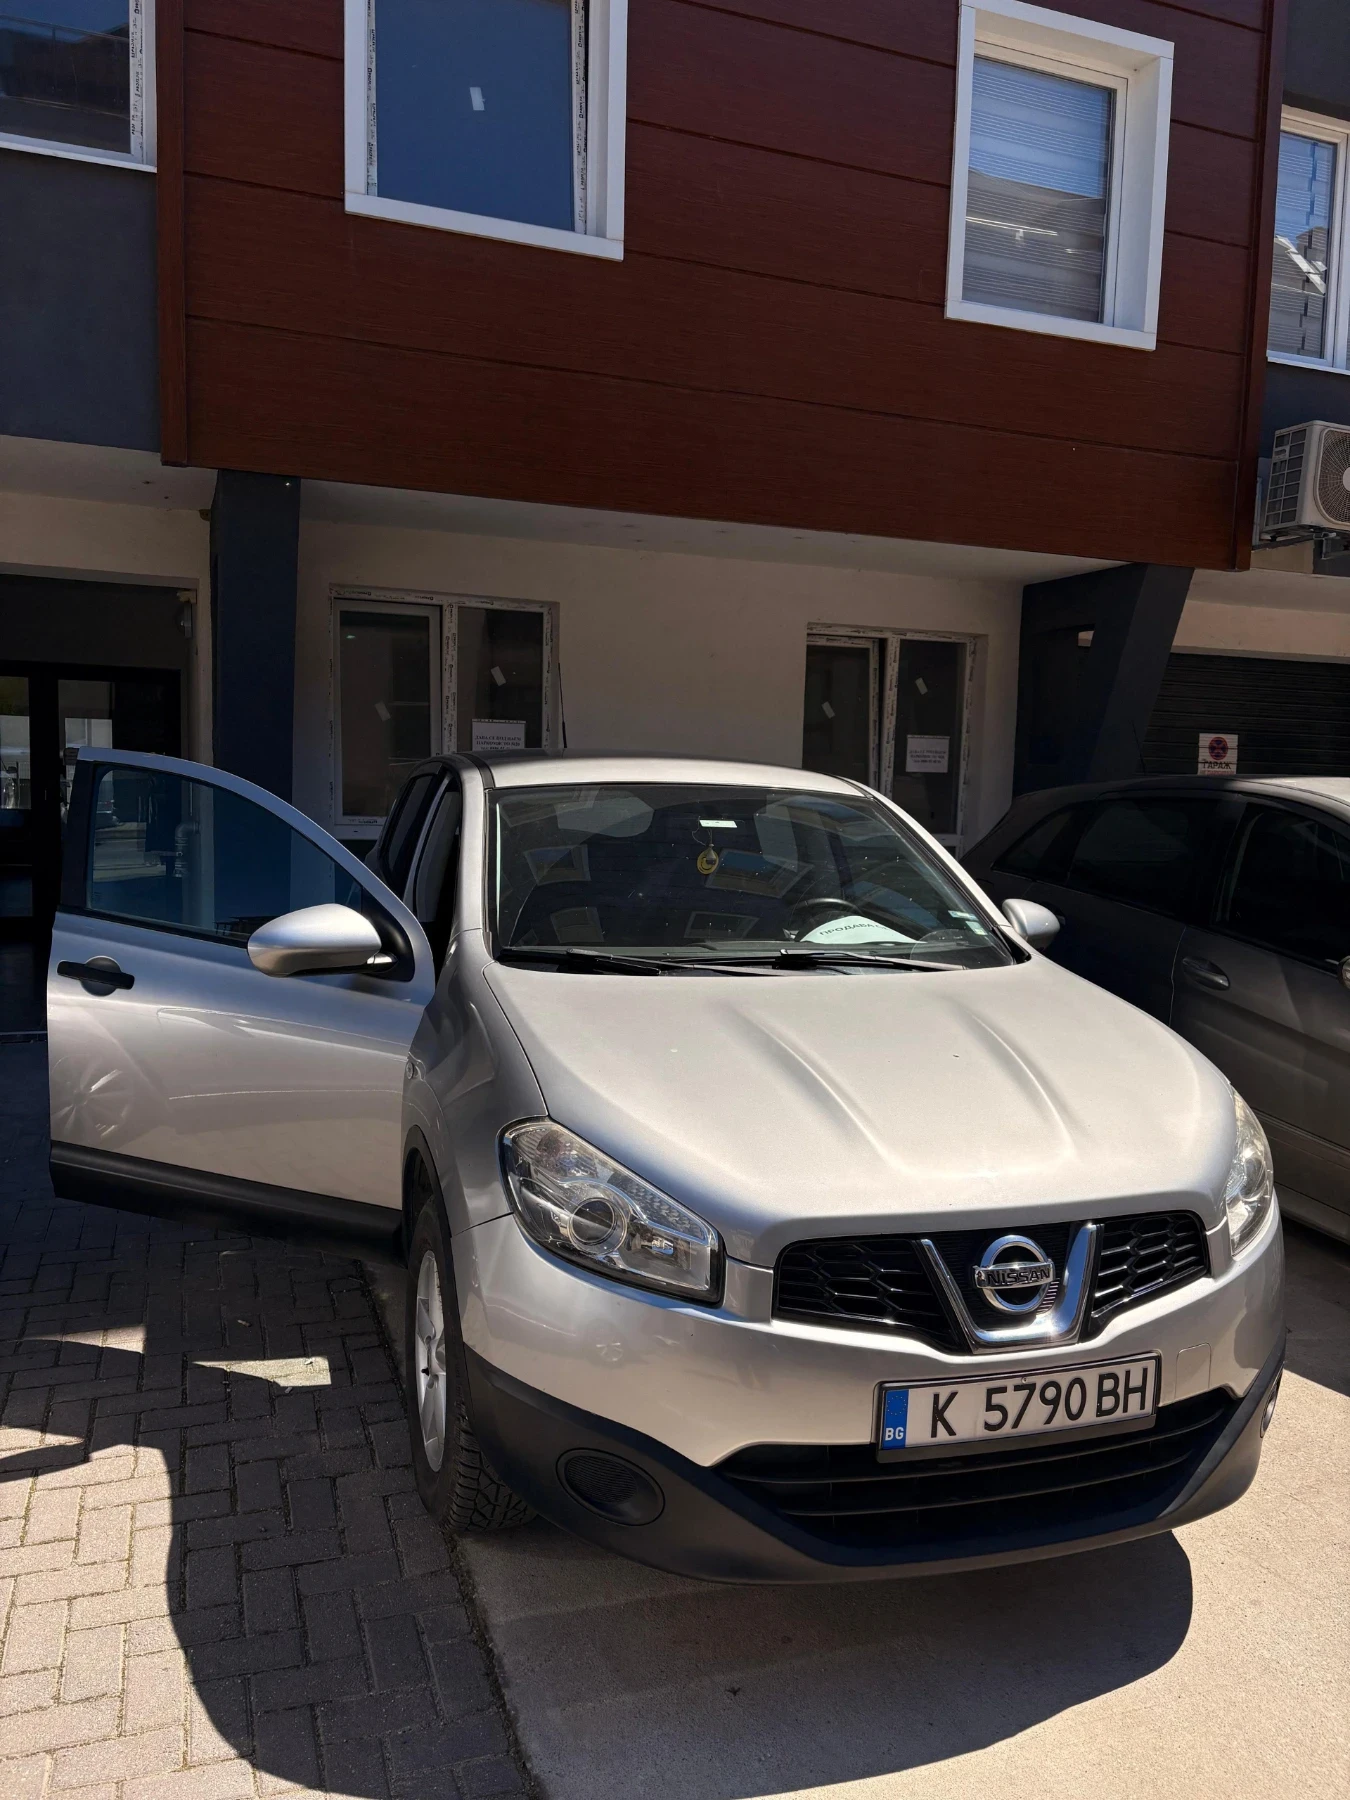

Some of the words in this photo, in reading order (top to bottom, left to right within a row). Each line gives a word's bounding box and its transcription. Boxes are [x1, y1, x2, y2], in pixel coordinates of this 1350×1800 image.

[819, 924, 875, 936] ПРОДАВА
[986, 1267, 1051, 1285] NISSAN
[884, 1427, 905, 1441] BG
[930, 1391, 959, 1438] K
[984, 1377, 1088, 1432] 5790
[1095, 1367, 1149, 1418] BH
